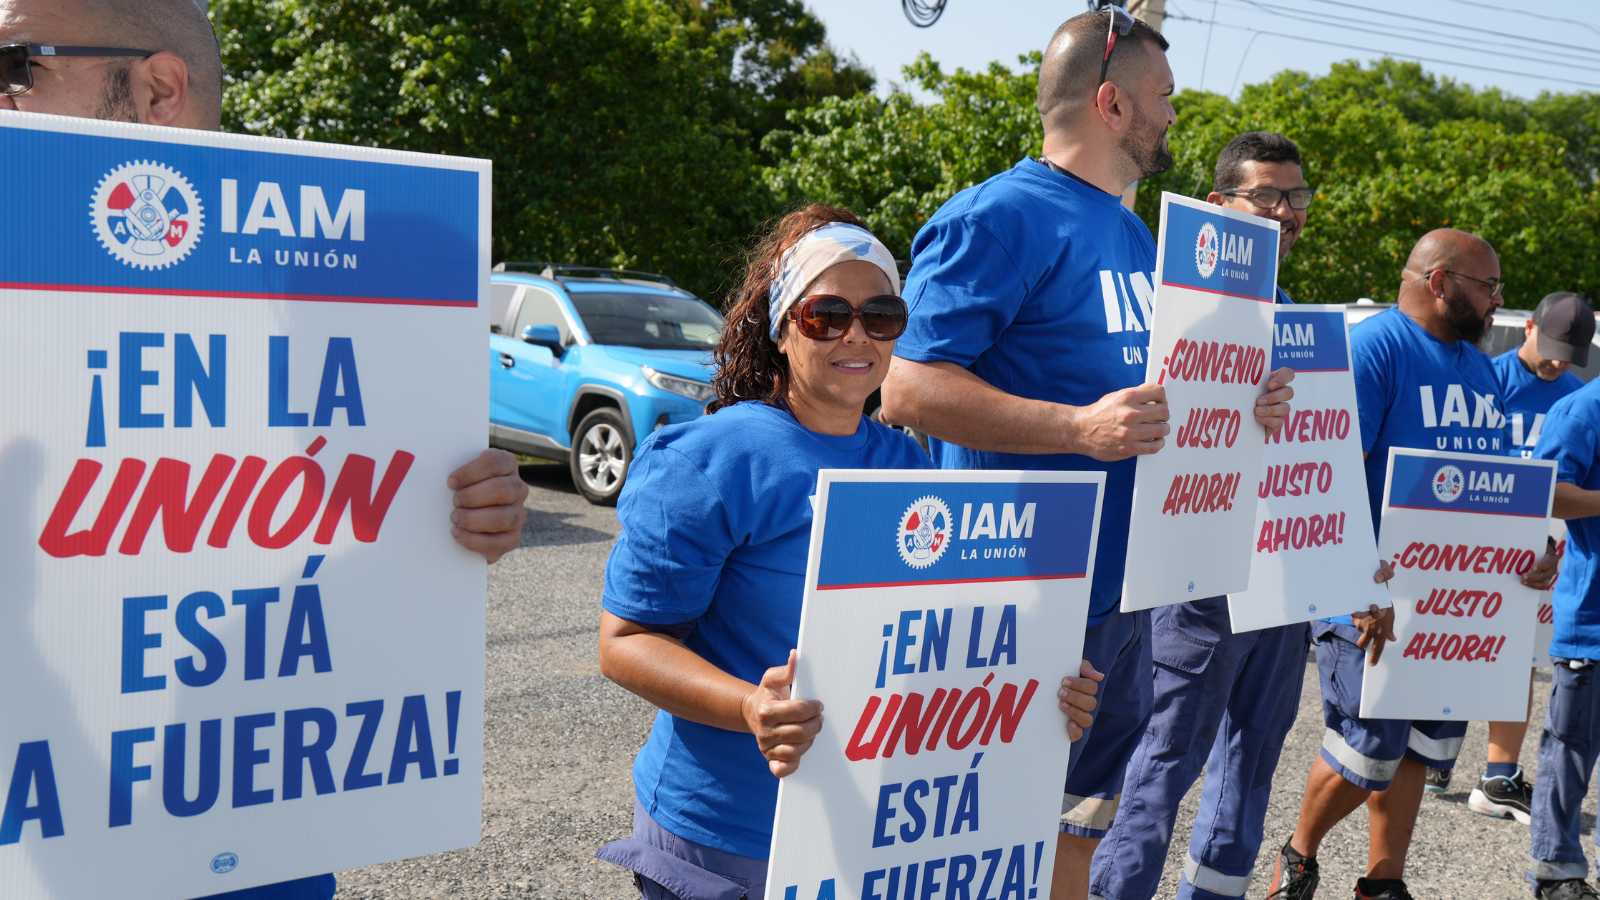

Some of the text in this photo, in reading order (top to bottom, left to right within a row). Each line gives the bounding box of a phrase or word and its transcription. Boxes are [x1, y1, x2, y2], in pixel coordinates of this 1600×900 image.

[222, 178, 365, 241] IAM
[230, 247, 357, 269] LA UNIÓN
[1221, 232, 1253, 266] IAM
[1221, 267, 1249, 281] LA UNIÓN
[1274, 323, 1315, 346] IAM
[1158, 338, 1265, 386] ¡CONVENIO
[1278, 350, 1314, 359] LA UNIÓN
[86, 332, 366, 447] ¡EN LA
[1419, 384, 1507, 428] IAM
[1177, 408, 1240, 448] JUSTO
[1436, 436, 1500, 450] UNION
[38, 435, 415, 558] UNIÓN
[1162, 472, 1240, 516] AHORA!
[1258, 462, 1332, 498] JUSTO
[1468, 470, 1515, 493] IAM
[959, 502, 1037, 540] IAM
[1257, 511, 1345, 553] AHORA!
[961, 545, 1027, 560] LA UNIÓN
[1389, 542, 1536, 576] ¡CONVENIO
[1415, 588, 1503, 618] JUSTO
[121, 555, 333, 694] ESTÁ
[875, 604, 1017, 689] ¡EN LA
[1403, 632, 1507, 662] AHORA!
[844, 672, 1040, 762] UNIÓN
[0, 690, 462, 846] A FUERZA!
[872, 751, 984, 849] ESTÁ
